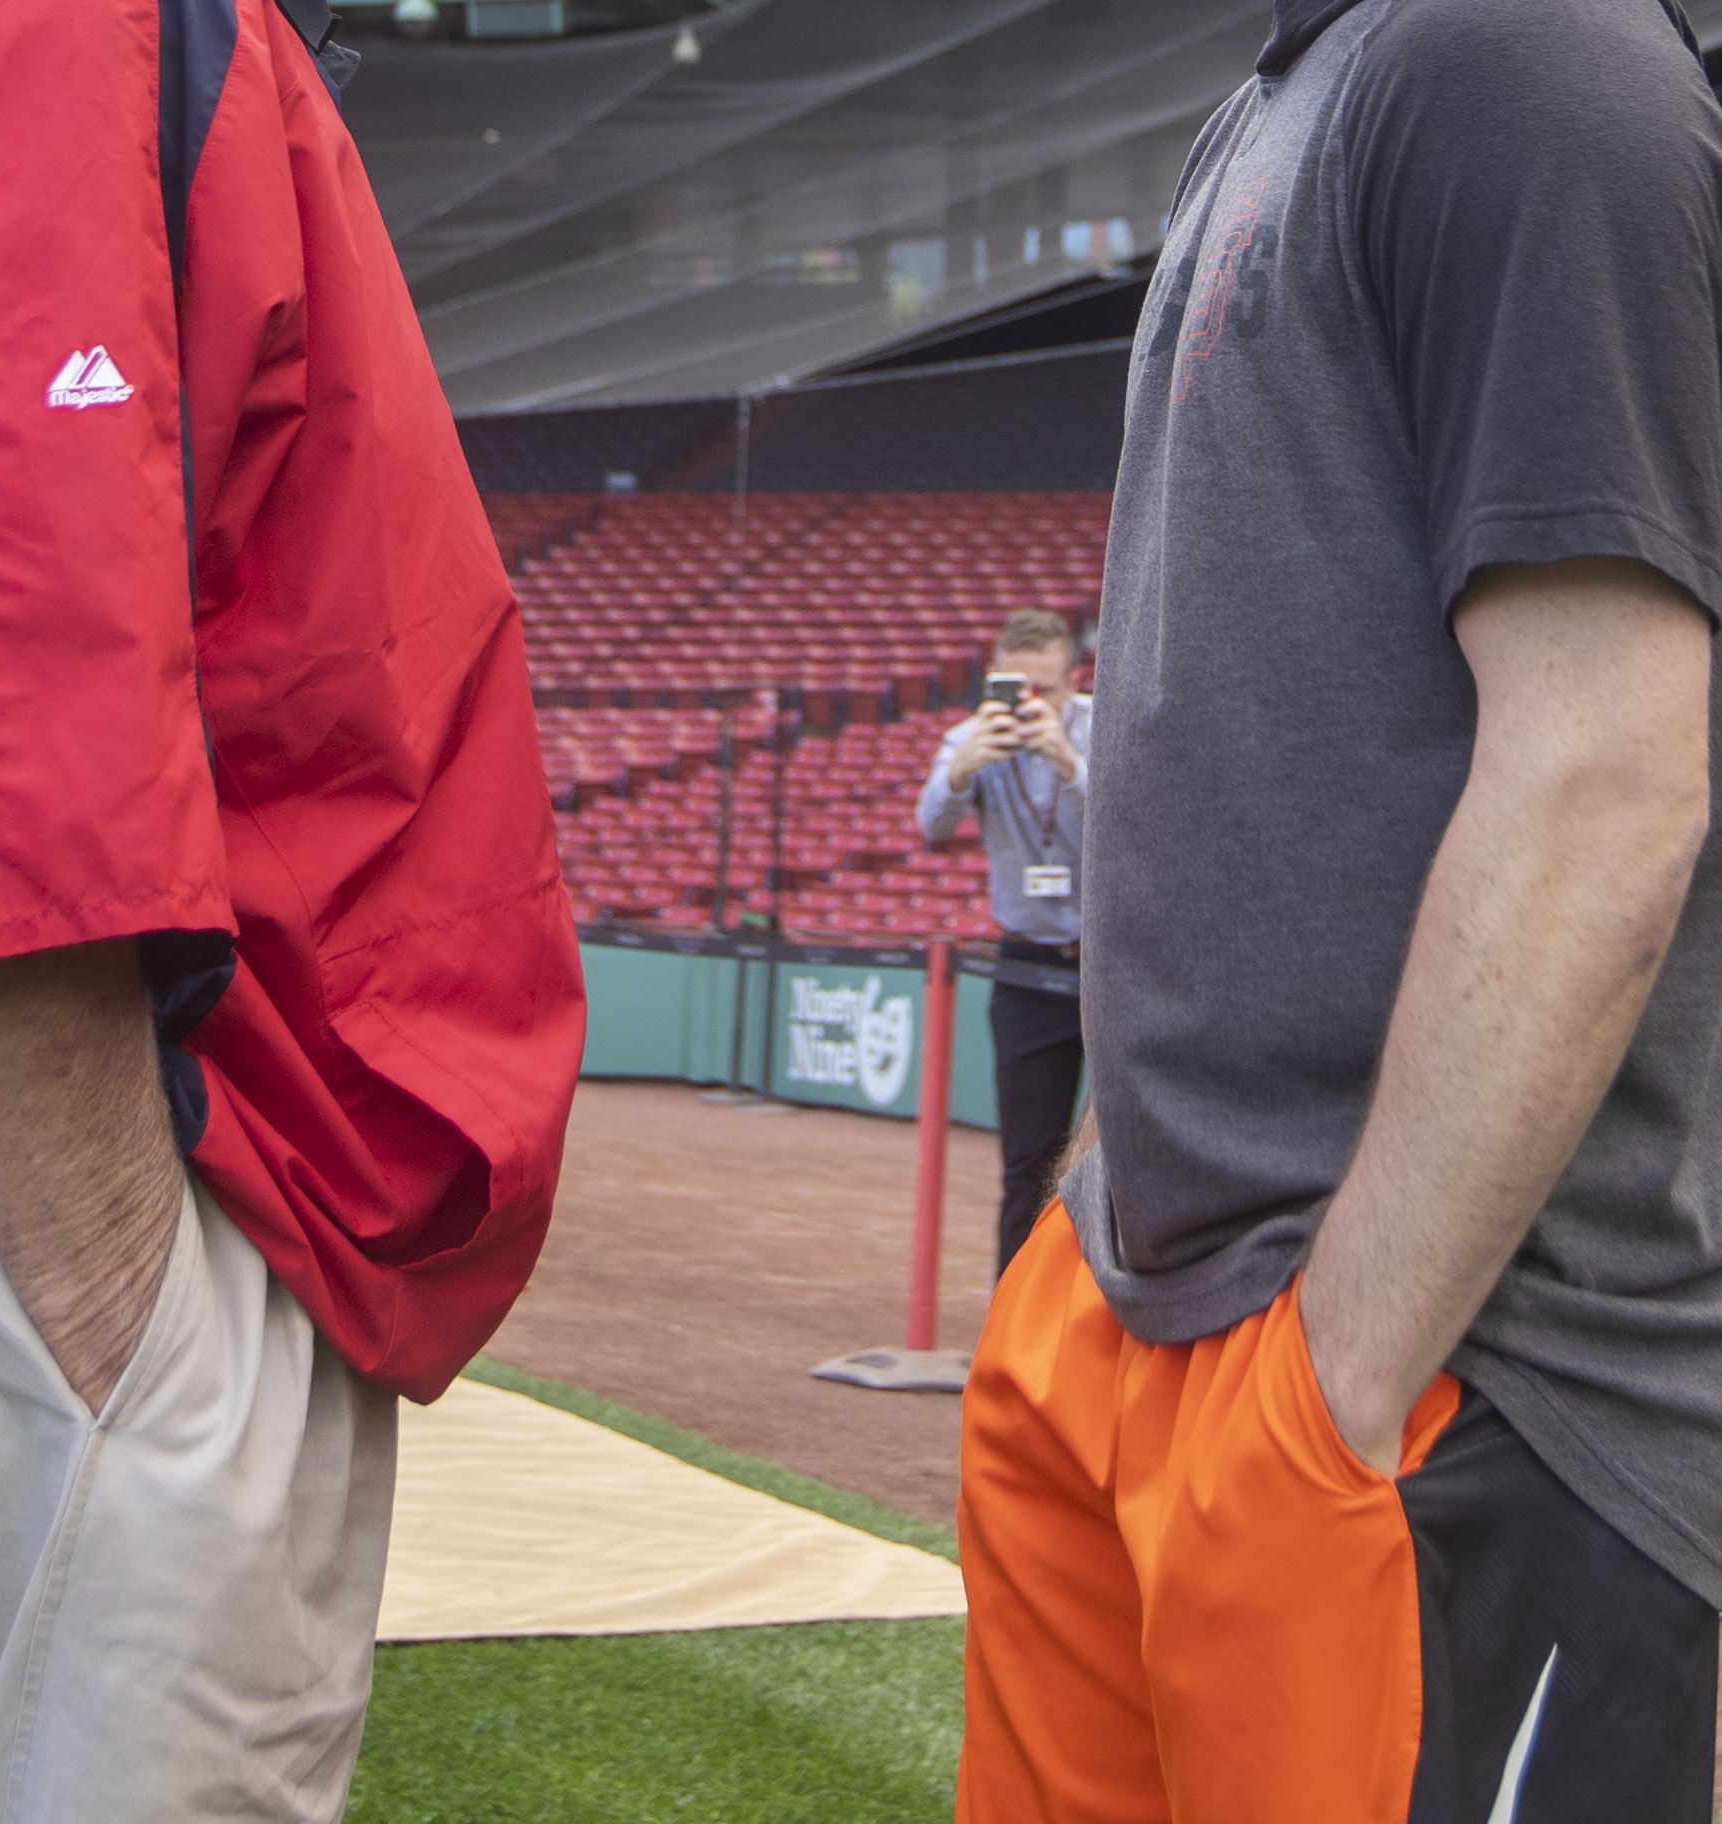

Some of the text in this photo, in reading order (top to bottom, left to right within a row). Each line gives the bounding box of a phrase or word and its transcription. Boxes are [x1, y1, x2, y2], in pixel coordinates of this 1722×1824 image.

[50, 386, 132, 409] Majestic
[789, 976, 881, 1038] Ninety
[788, 1025, 855, 1087] Nine
